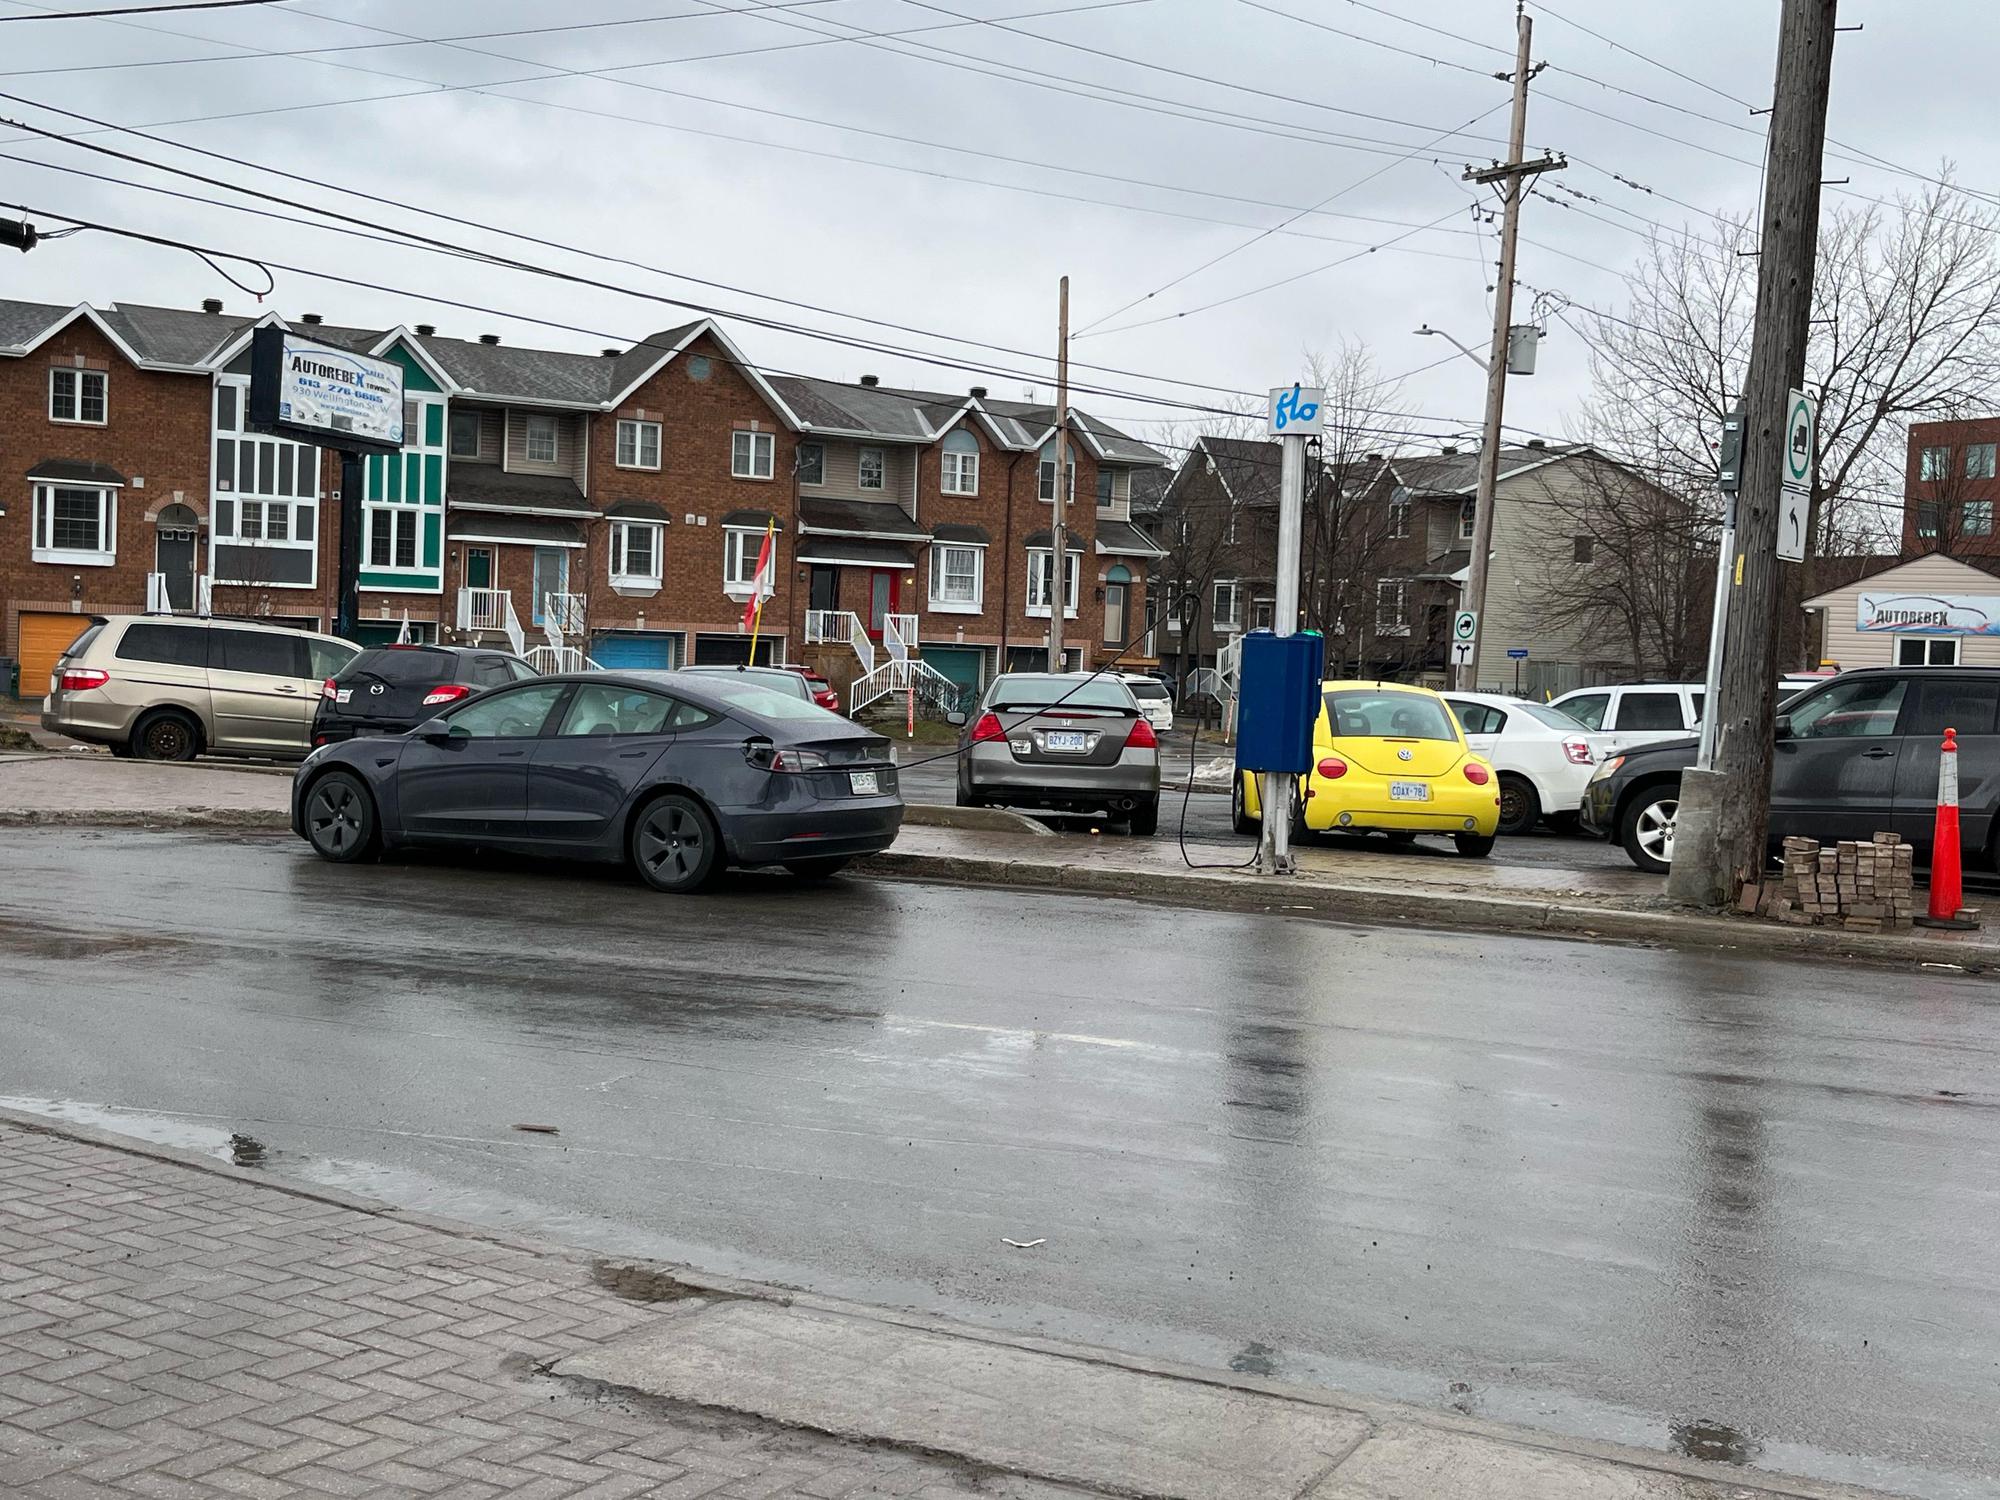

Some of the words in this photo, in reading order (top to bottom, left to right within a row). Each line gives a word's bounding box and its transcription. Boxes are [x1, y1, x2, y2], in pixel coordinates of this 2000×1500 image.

[291, 356, 365, 388] AUTOREBEX
[298, 377, 321, 389] 613
[292, 385, 312, 397] 930
[313, 390, 365, 409] Wellington
[380, 405, 391, 414] W
[1276, 382, 1318, 430] flo
